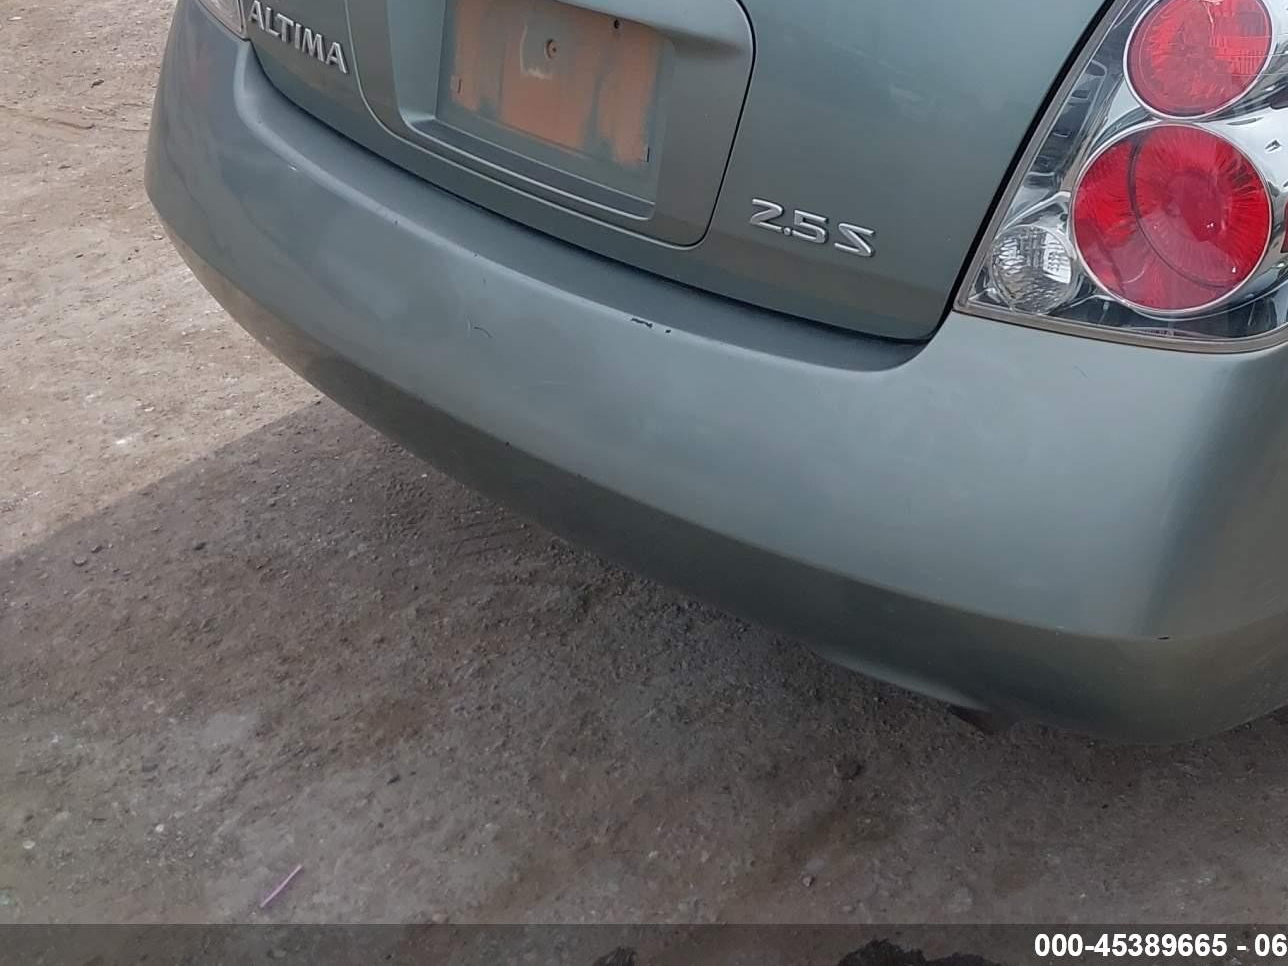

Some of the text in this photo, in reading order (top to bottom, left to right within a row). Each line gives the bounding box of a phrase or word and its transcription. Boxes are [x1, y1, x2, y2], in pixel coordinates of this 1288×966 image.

[248, 0, 348, 74] ALTIMA
[750, 197, 875, 257] 2.5 S
